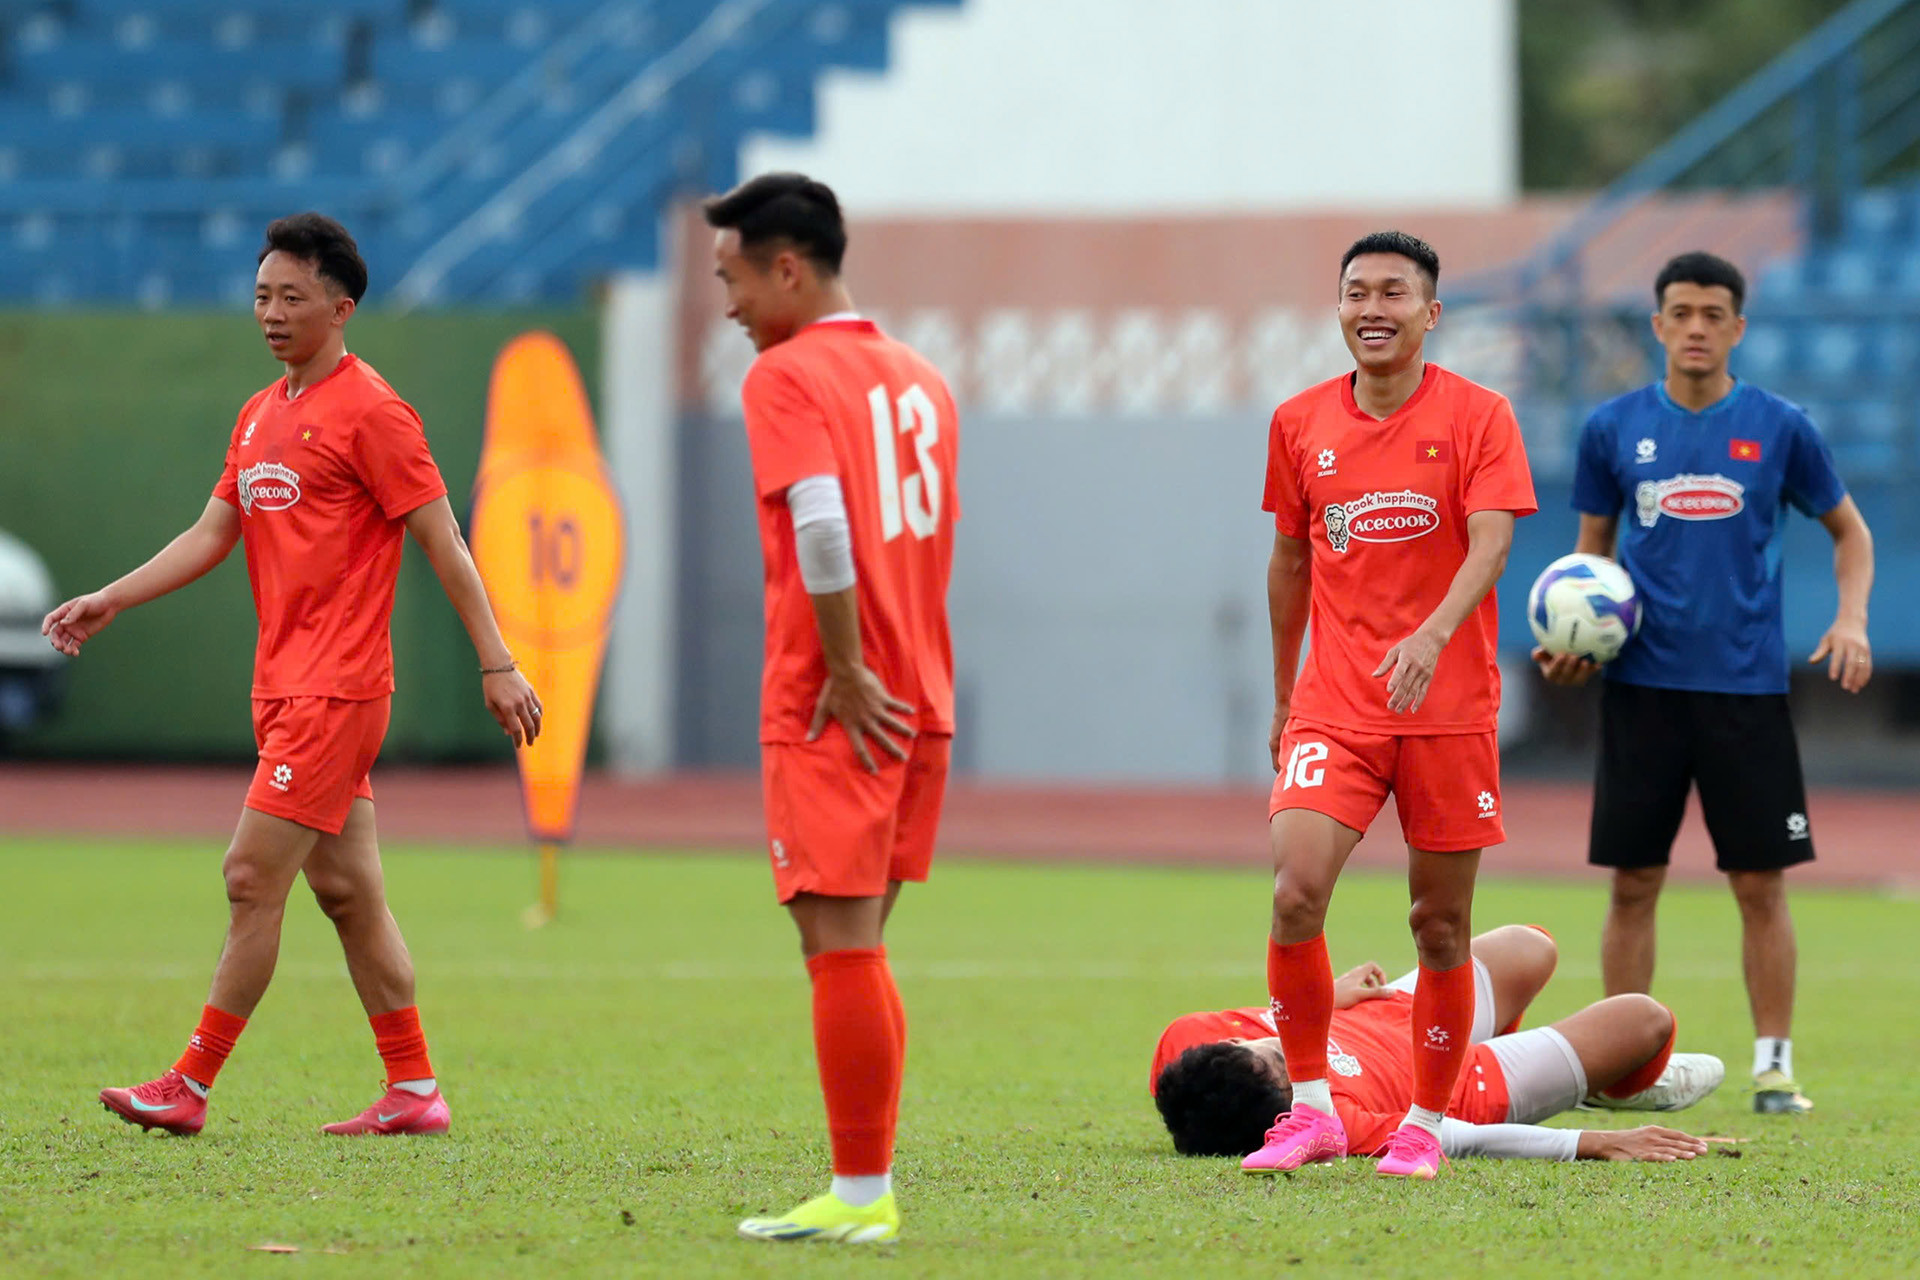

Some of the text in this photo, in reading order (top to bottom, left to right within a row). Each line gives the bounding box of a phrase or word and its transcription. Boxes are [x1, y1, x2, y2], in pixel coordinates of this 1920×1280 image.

[245, 465, 298, 483] Cook happiness
[867, 383, 940, 543] 13
[1346, 493, 1435, 514] Cook happiness
[530, 512, 582, 588] 10
[1283, 741, 1328, 791] 12
